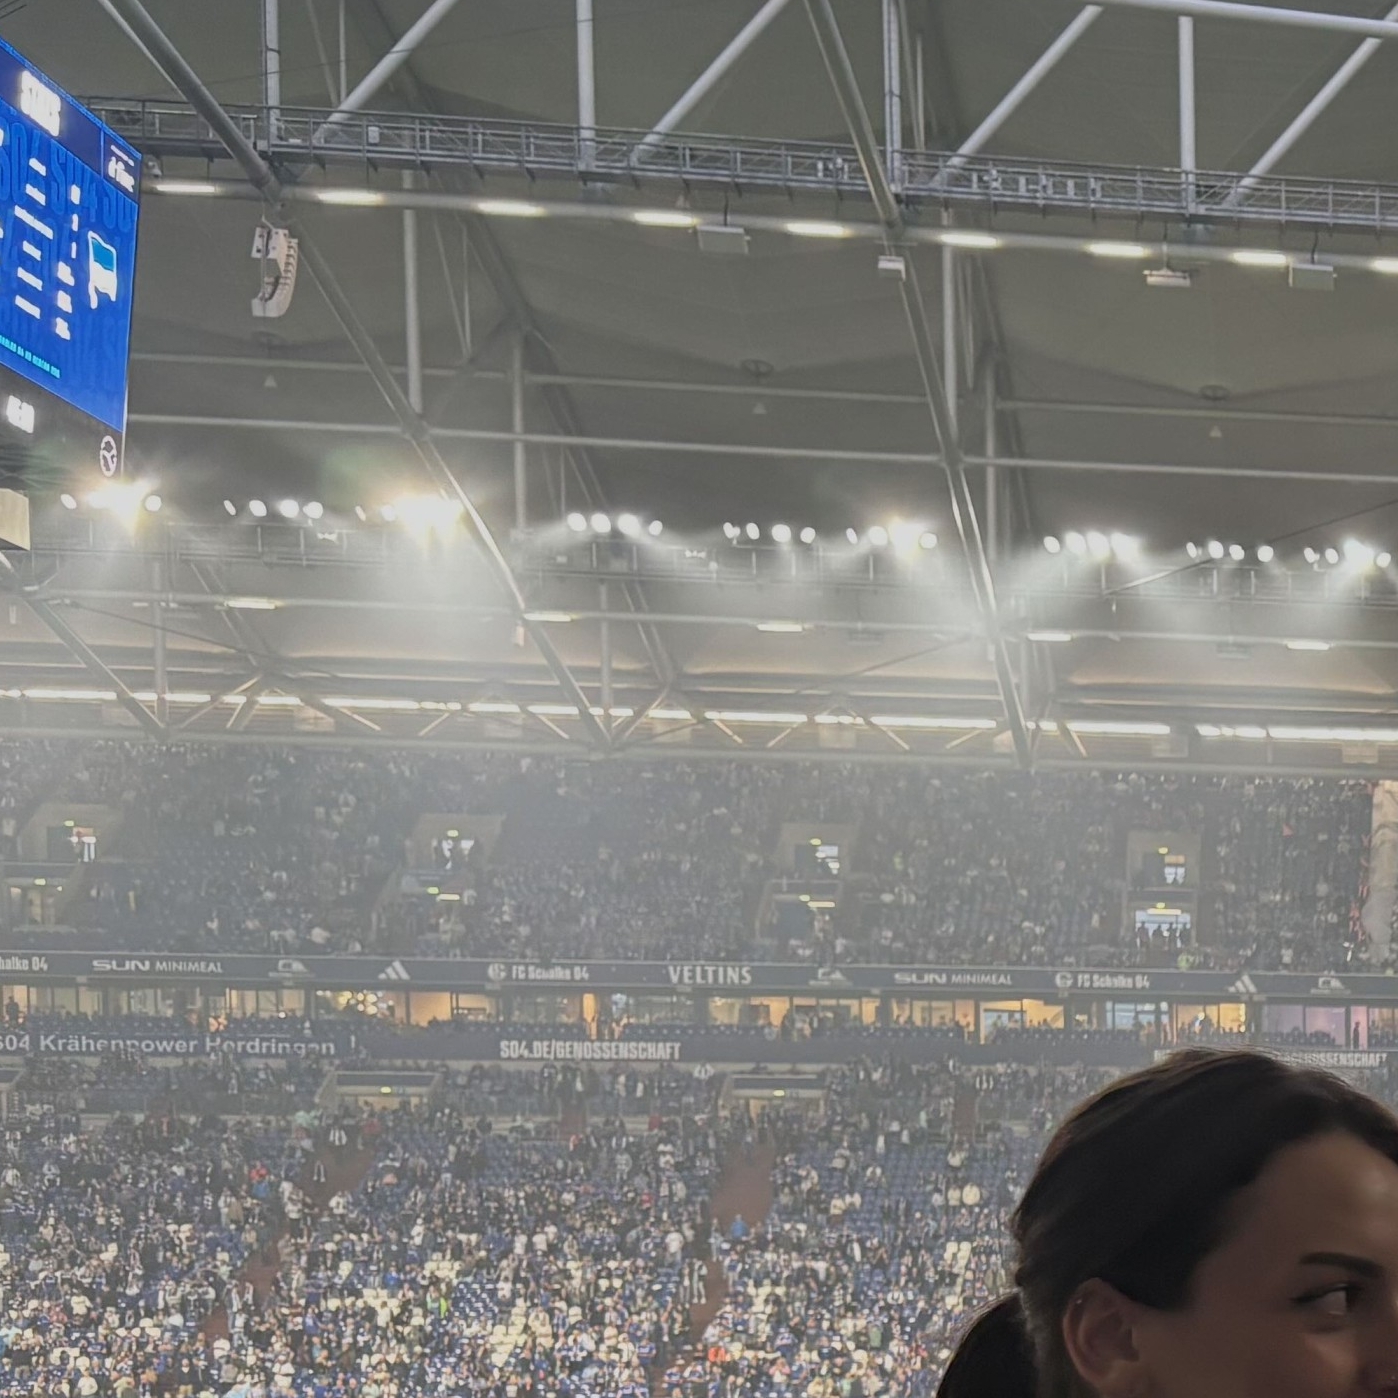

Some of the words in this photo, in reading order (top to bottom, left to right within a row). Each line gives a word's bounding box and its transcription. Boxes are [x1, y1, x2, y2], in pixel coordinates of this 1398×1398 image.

[31, 956, 48, 971] 04
[92, 958, 150, 972] SUN
[155, 960, 223, 974] MINIMEAL
[667, 965, 752, 985] VELTINS
[894, 972, 947, 985] SUN
[951, 974, 1013, 986] MINIMEAL
